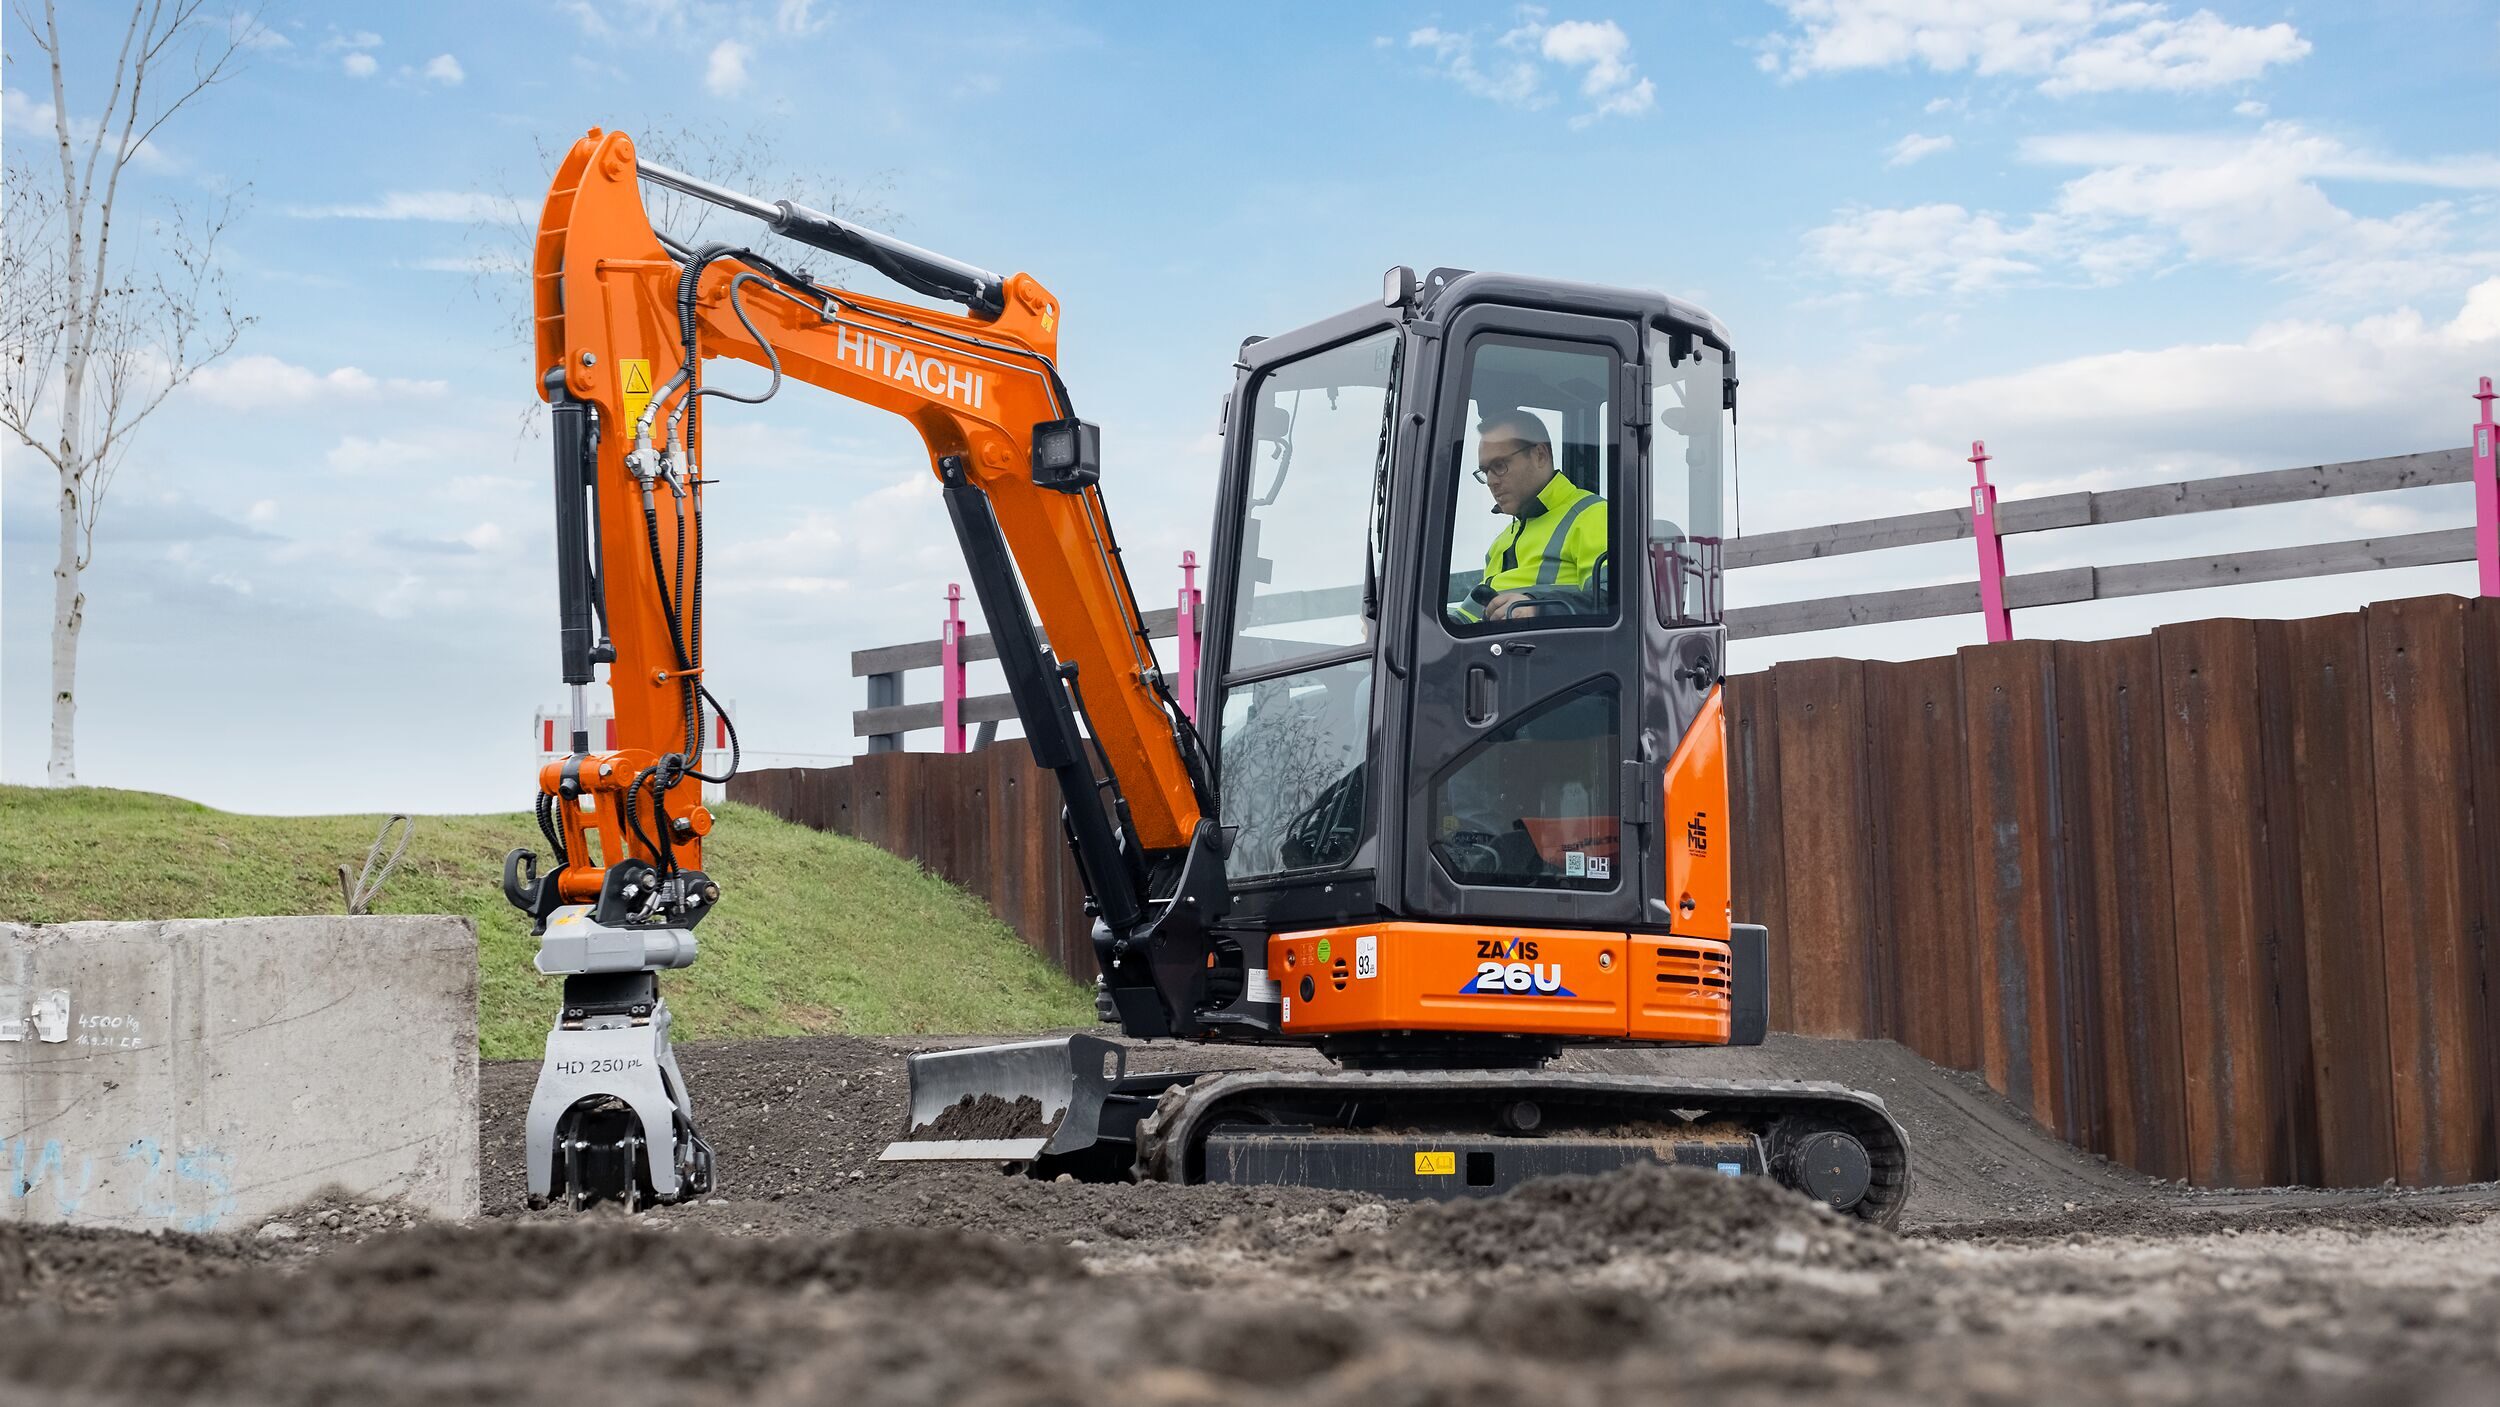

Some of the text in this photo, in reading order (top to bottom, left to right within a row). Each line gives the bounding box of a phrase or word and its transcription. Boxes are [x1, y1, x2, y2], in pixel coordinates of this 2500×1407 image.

[837, 325, 983, 409] HITACHI
[1476, 937, 1539, 960] ZAXIS
[1358, 955, 1370, 976] 93
[1476, 961, 1562, 996] 26U
[78, 1014, 122, 1028] 4500
[556, 1061, 584, 1074] HD
[590, 1059, 624, 1073] 250
